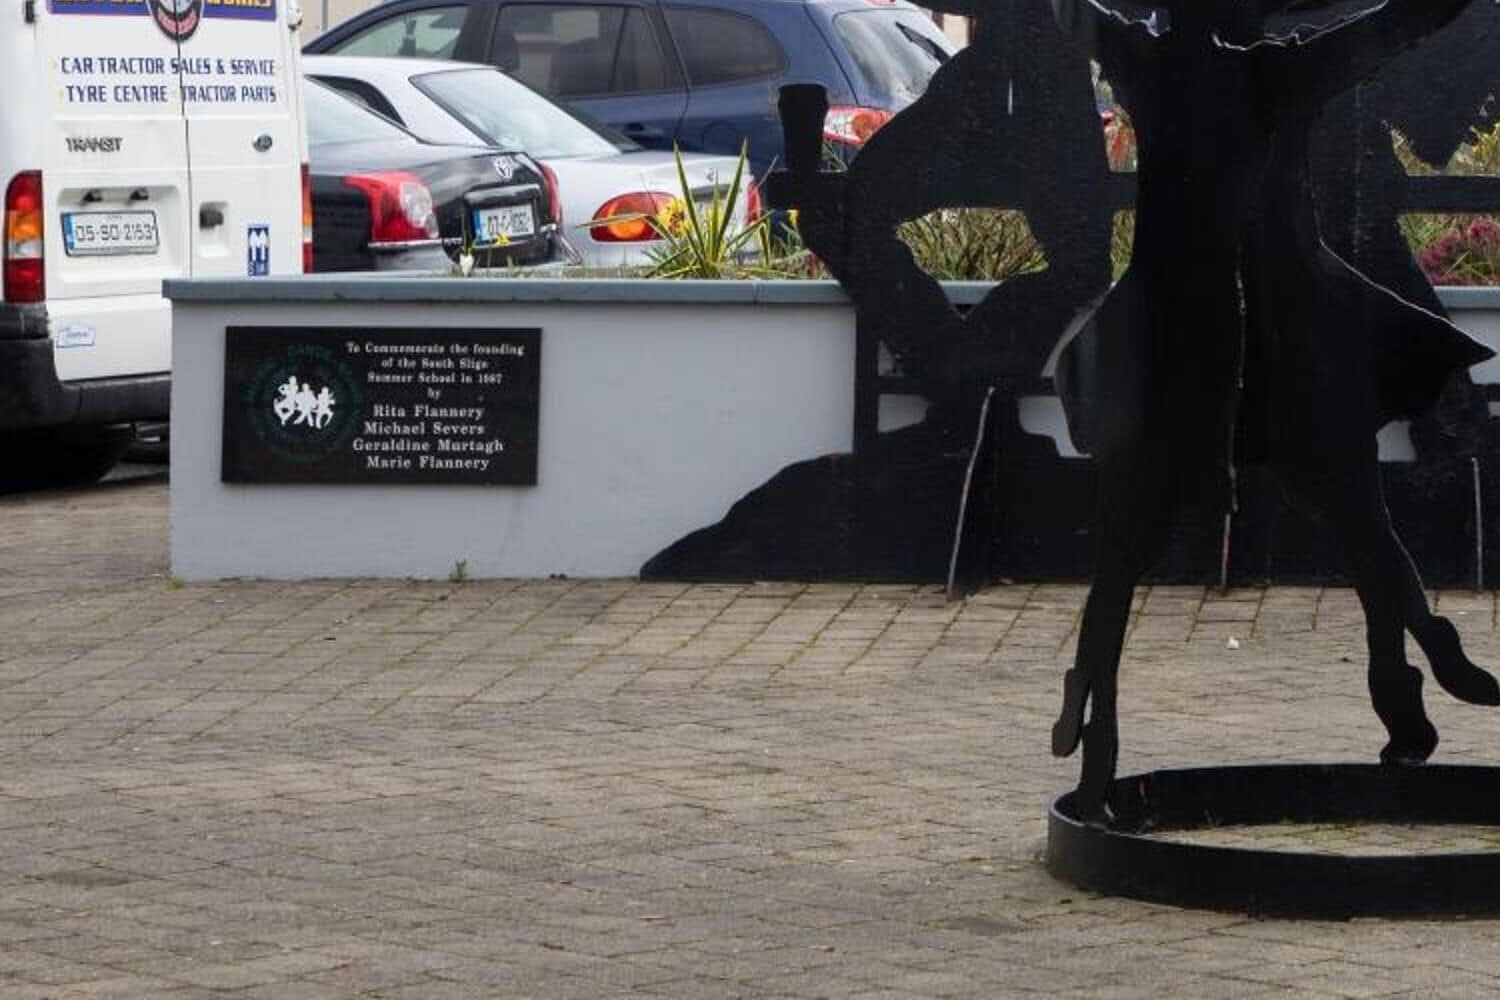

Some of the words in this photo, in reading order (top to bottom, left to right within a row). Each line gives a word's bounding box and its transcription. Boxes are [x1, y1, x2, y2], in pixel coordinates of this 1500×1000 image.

[60, 56, 94, 75] CAR
[98, 57, 165, 75] TRACTOR
[170, 57, 211, 76] SALES
[215, 58, 226, 75] &
[230, 59, 276, 77] SERVICE
[65, 85, 107, 104] TYRE
[112, 85, 168, 104] CENTRE
[181, 85, 237, 104] TRACTOR
[241, 86, 277, 104] PARTS
[450, 343, 469, 355] the
[473, 343, 525, 358] founding
[373, 404, 406, 417] Rita
[414, 404, 485, 422] Flannery
[364, 421, 425, 435] Michael
[352, 437, 430, 452] Geraldine
[437, 438, 505, 455] Murtagh
[366, 455, 412, 470] Marie
[418, 455, 491, 472] Flannery
